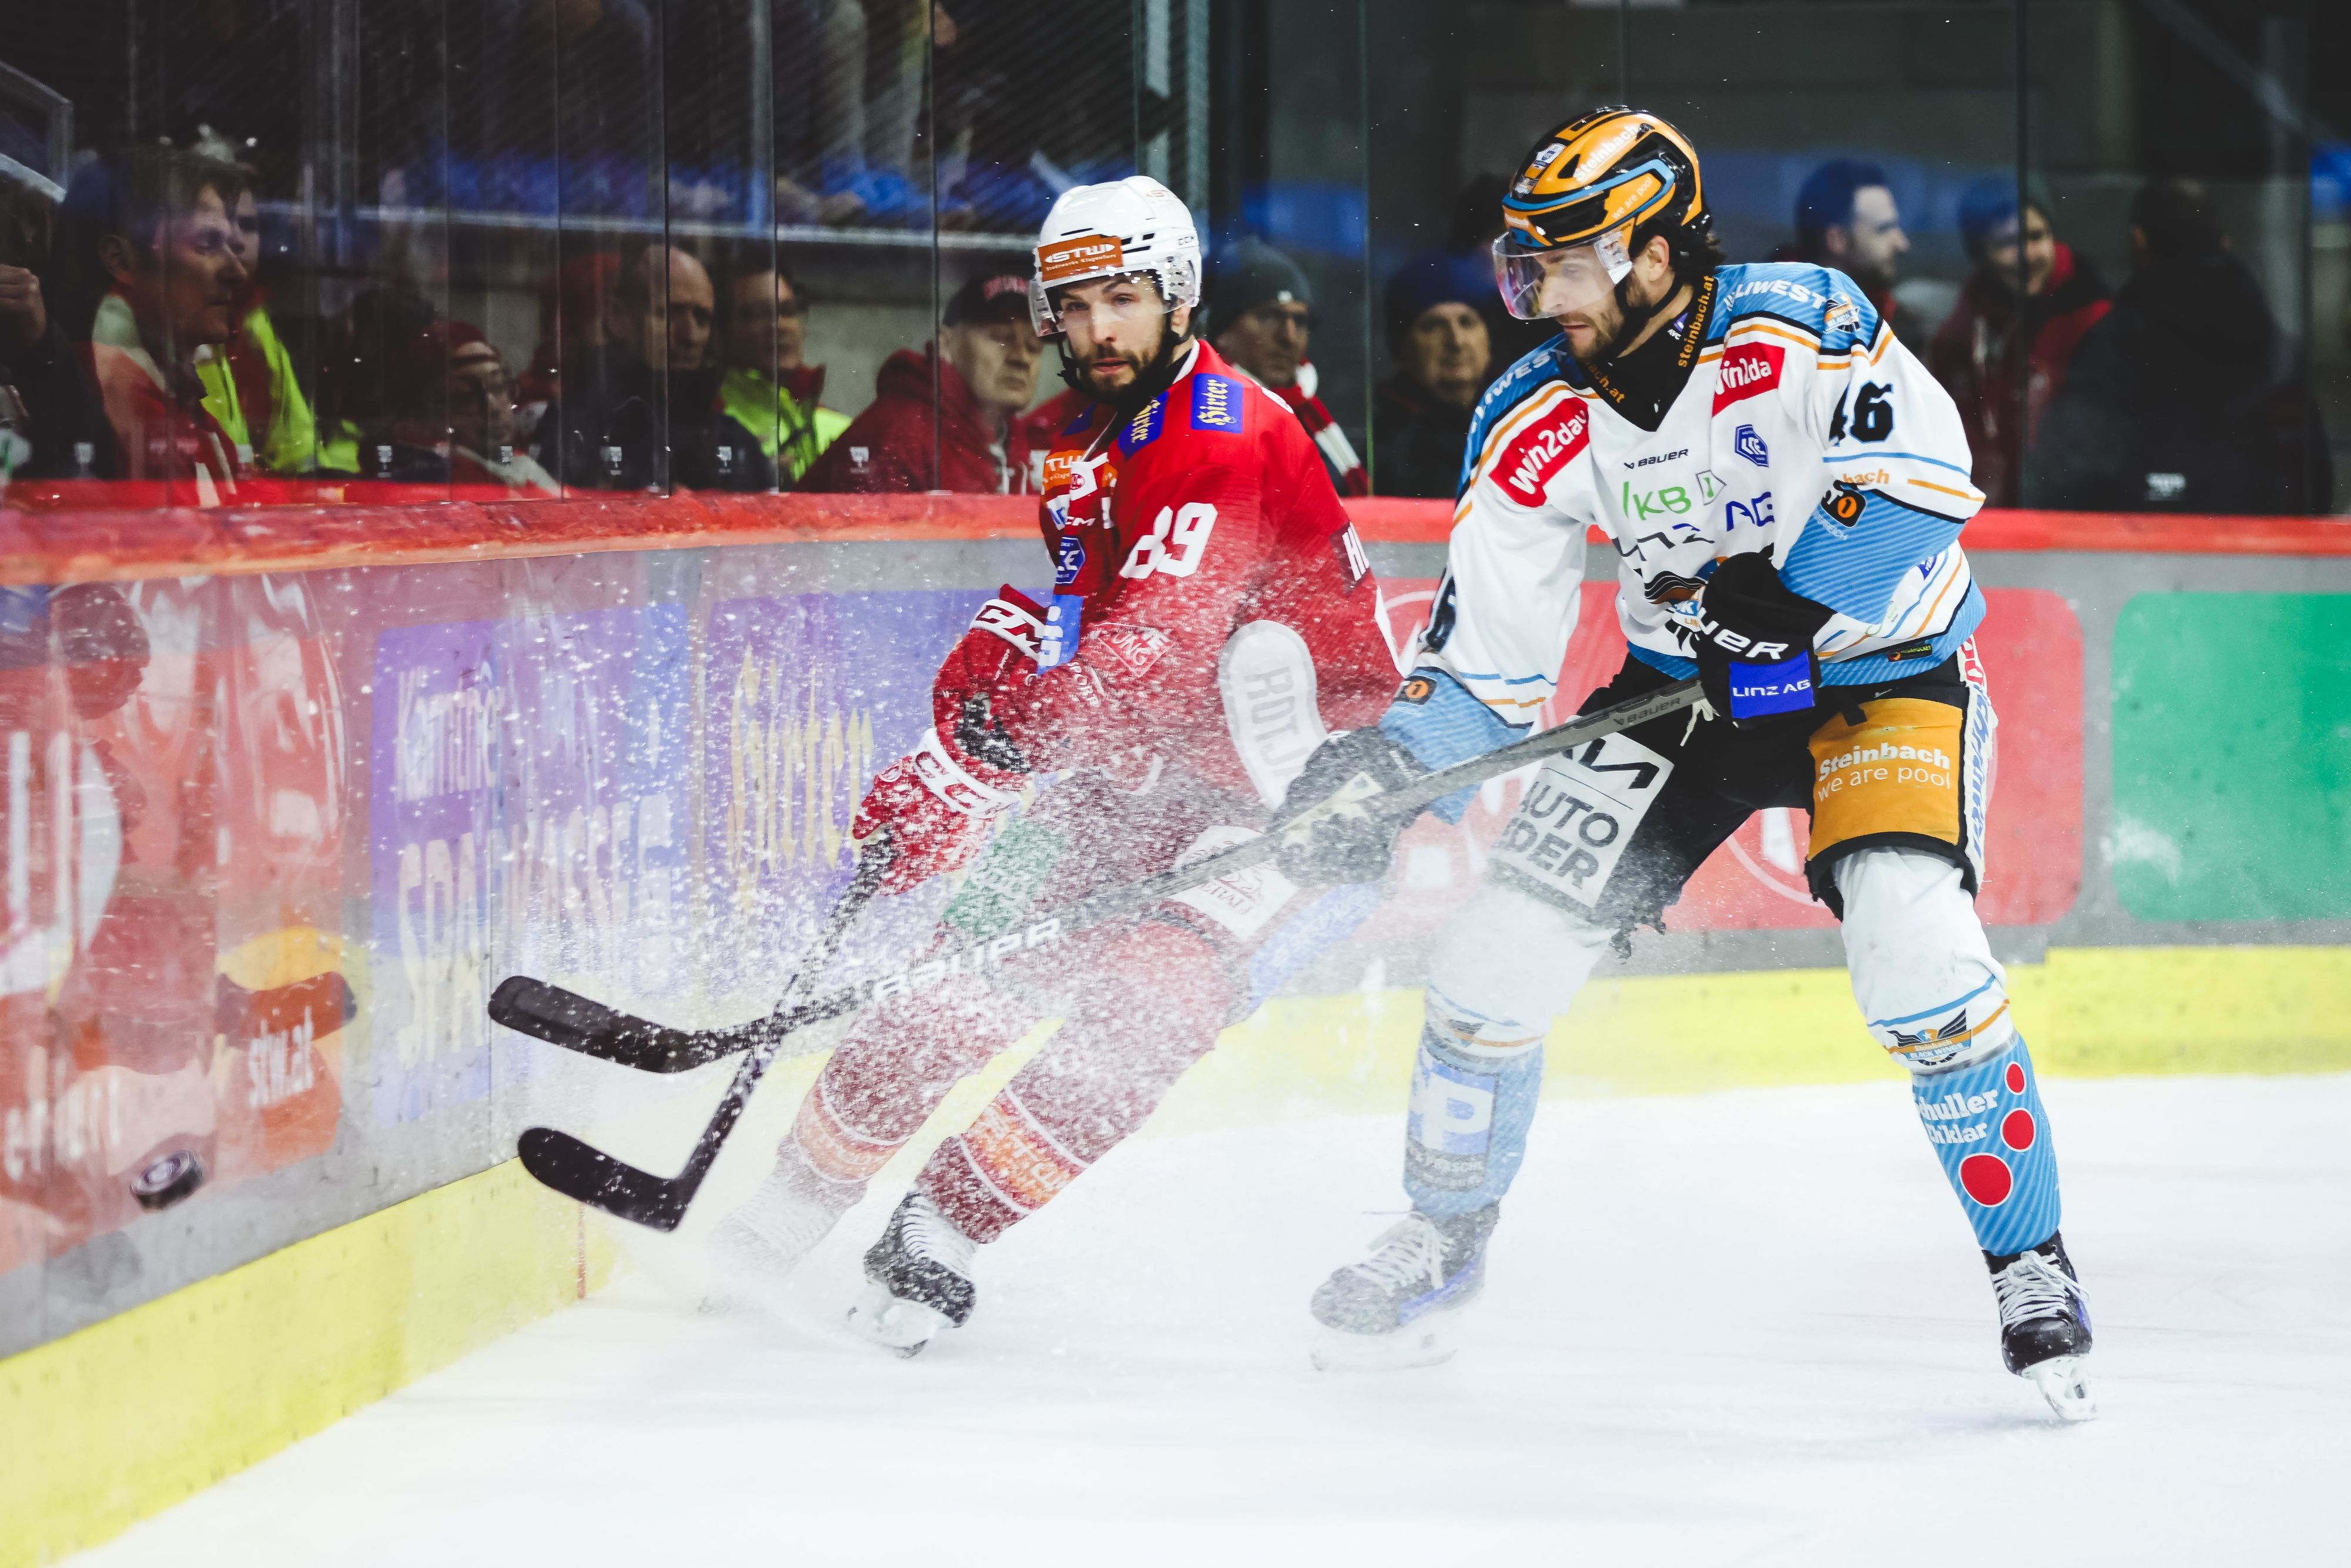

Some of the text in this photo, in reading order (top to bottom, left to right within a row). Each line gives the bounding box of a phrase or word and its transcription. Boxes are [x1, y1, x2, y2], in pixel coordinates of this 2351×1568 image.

[1573, 125, 1639, 182] Steinbach
[1612, 176, 1653, 219] we are pool
[1046, 243, 1114, 263] STW
[1667, 329, 1682, 340] AVC
[1679, 276, 1716, 367] steinbach.at
[1637, 448, 1689, 468] BAUER
[1119, 502, 1218, 579] 89
[1732, 679, 1811, 698] LINZ AG
[1627, 698, 1682, 723] BAUER
[1819, 741, 1951, 782] Steinbach
[1818, 765, 1951, 802] we are pool
[1934, 1043, 1964, 1056] WINGS
